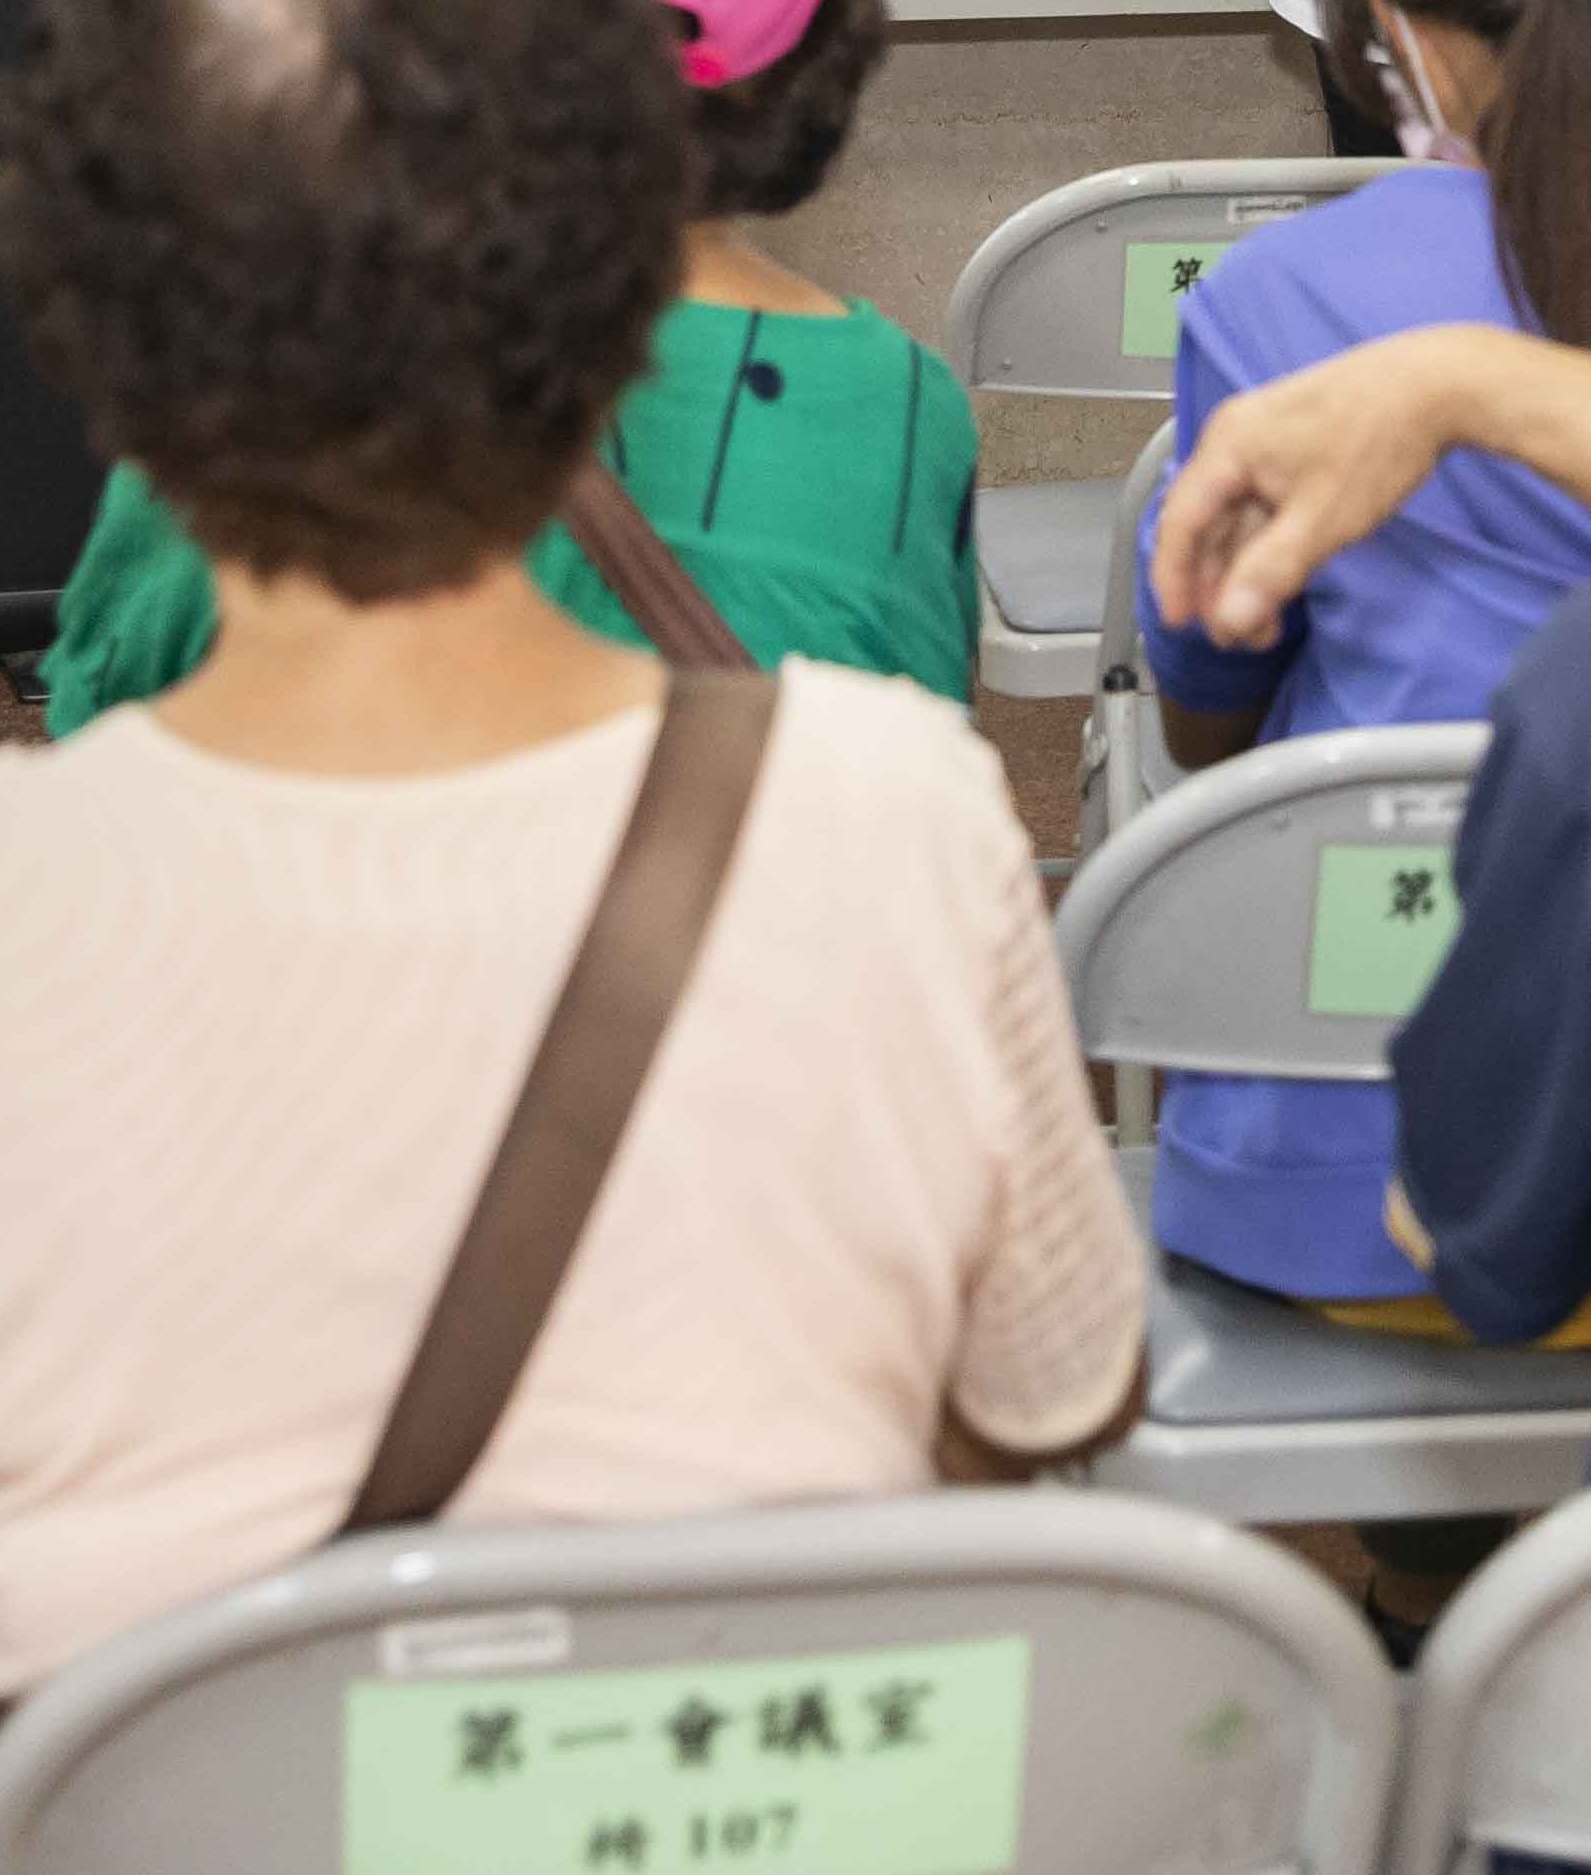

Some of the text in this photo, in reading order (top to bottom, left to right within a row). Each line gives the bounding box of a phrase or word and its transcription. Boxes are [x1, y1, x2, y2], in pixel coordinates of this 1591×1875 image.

[457, 1680, 938, 1782] 第一會議室
[687, 1806, 801, 1862] 107
